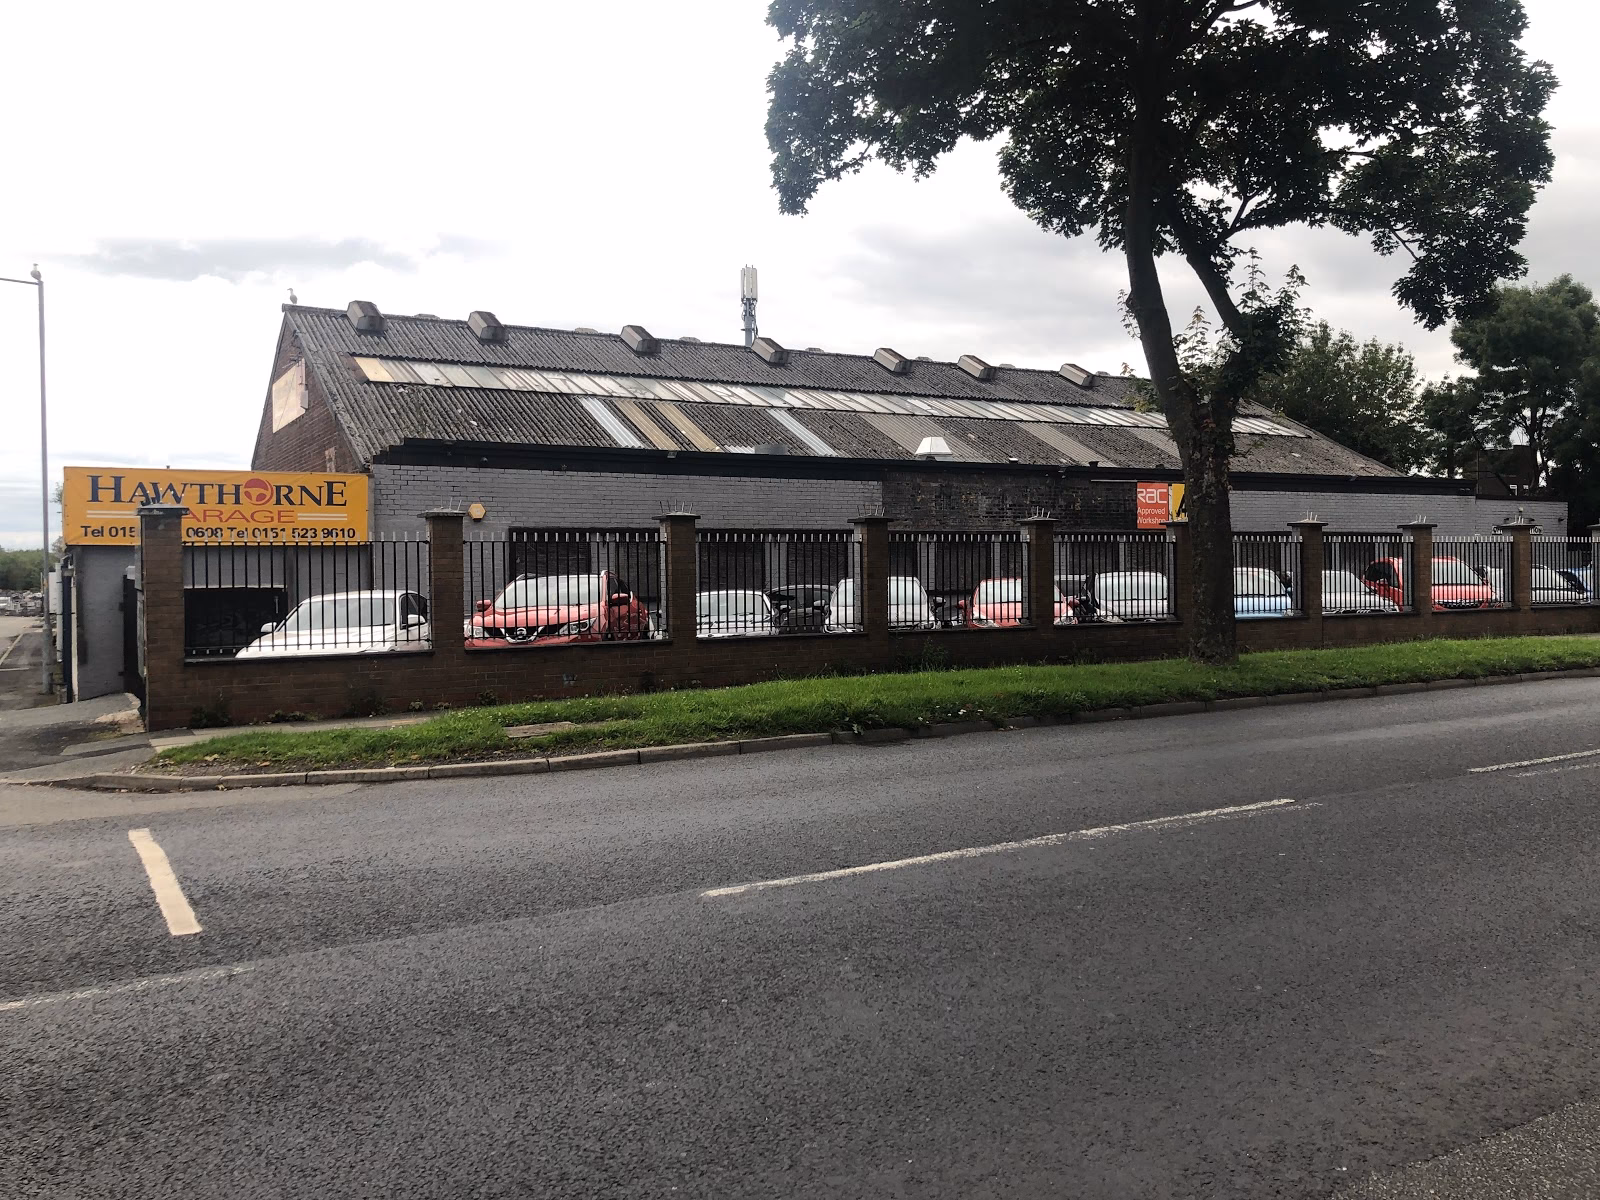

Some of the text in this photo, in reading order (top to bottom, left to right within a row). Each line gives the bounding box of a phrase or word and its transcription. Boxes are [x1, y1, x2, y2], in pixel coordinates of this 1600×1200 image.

[87, 475, 347, 506] HAWTHORNE
[181, 509, 296, 524] ARAGE
[1137, 507, 1165, 515] Approved
[80, 526, 104, 538] Tel
[109, 526, 136, 538] 015
[227, 527, 248, 539] Tel
[252, 527, 286, 539] 0151
[291, 528, 318, 539] 523
[322, 528, 356, 539] 9610
